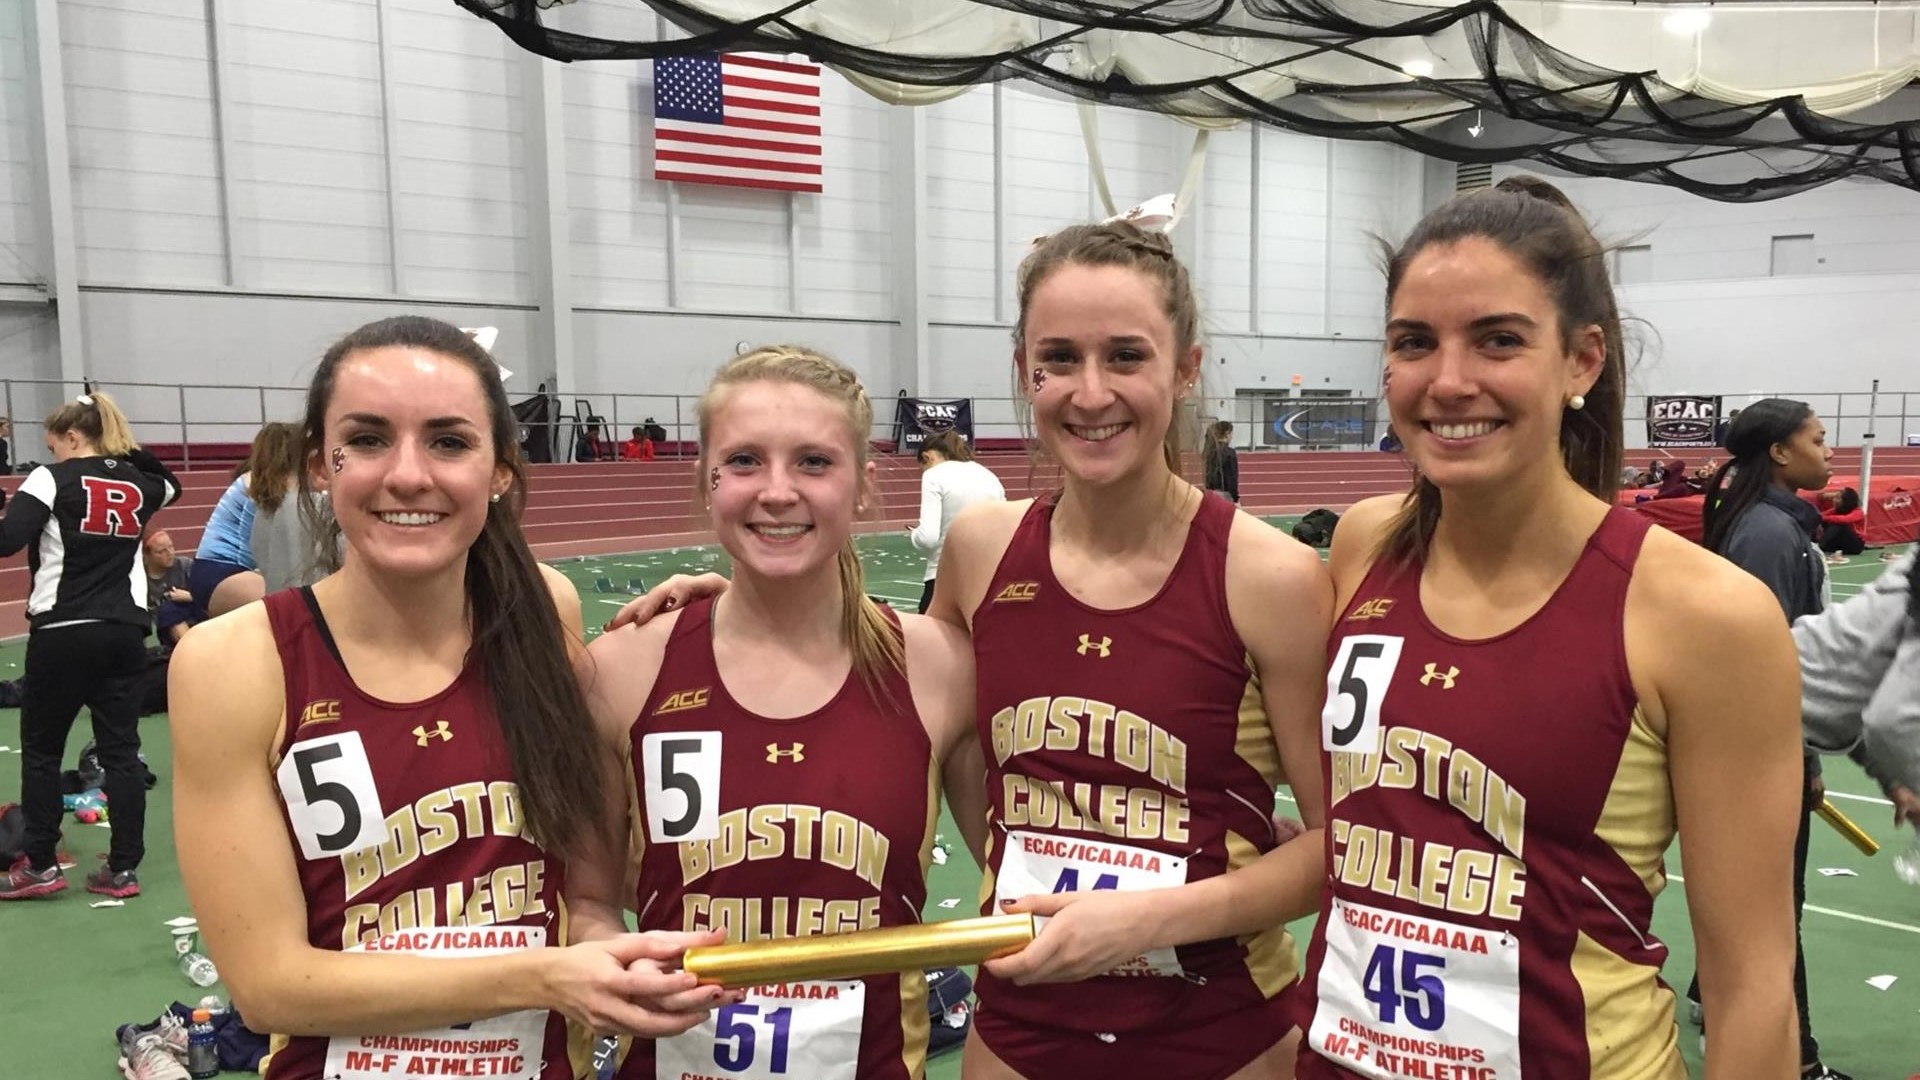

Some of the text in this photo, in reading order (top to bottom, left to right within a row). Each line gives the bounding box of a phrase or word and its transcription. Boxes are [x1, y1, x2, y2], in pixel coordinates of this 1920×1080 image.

[916, 404, 957, 419] ECAC
[1653, 401, 1714, 420] ECAC
[81, 475, 144, 538] R
[998, 582, 1039, 598] ACC
[1352, 598, 1393, 616] ACC
[300, 701, 340, 724] ACC
[660, 688, 709, 710] ACC
[1332, 643, 1384, 746] 5
[992, 696, 1187, 795] BOSTON
[293, 742, 361, 851] 5
[661, 738, 702, 837] 5
[1003, 773, 1190, 843] COLLEGE
[1331, 726, 1526, 860] BOSTON
[340, 781, 535, 902] BOSTO
[678, 803, 890, 892] BOSTON
[1022, 836, 1161, 873] ECAC/ICAAAA
[1332, 818, 1527, 921] COLLEGE
[342, 859, 547, 950] COLLEGE
[1342, 906, 1489, 955] ECAC/ICAAAA
[364, 931, 528, 951] ECAC/ICAAAA
[1363, 943, 1446, 1032] 45
[345, 1051, 524, 1077] M-F ATHLETIC
[360, 1036, 519, 1054] CHAMPIONSHIPS
[713, 1003, 793, 1074] 51
[1324, 1032, 1497, 1080] M-F ATHLETIC
[1339, 1016, 1486, 1064] CHAMPIONSHIPS
